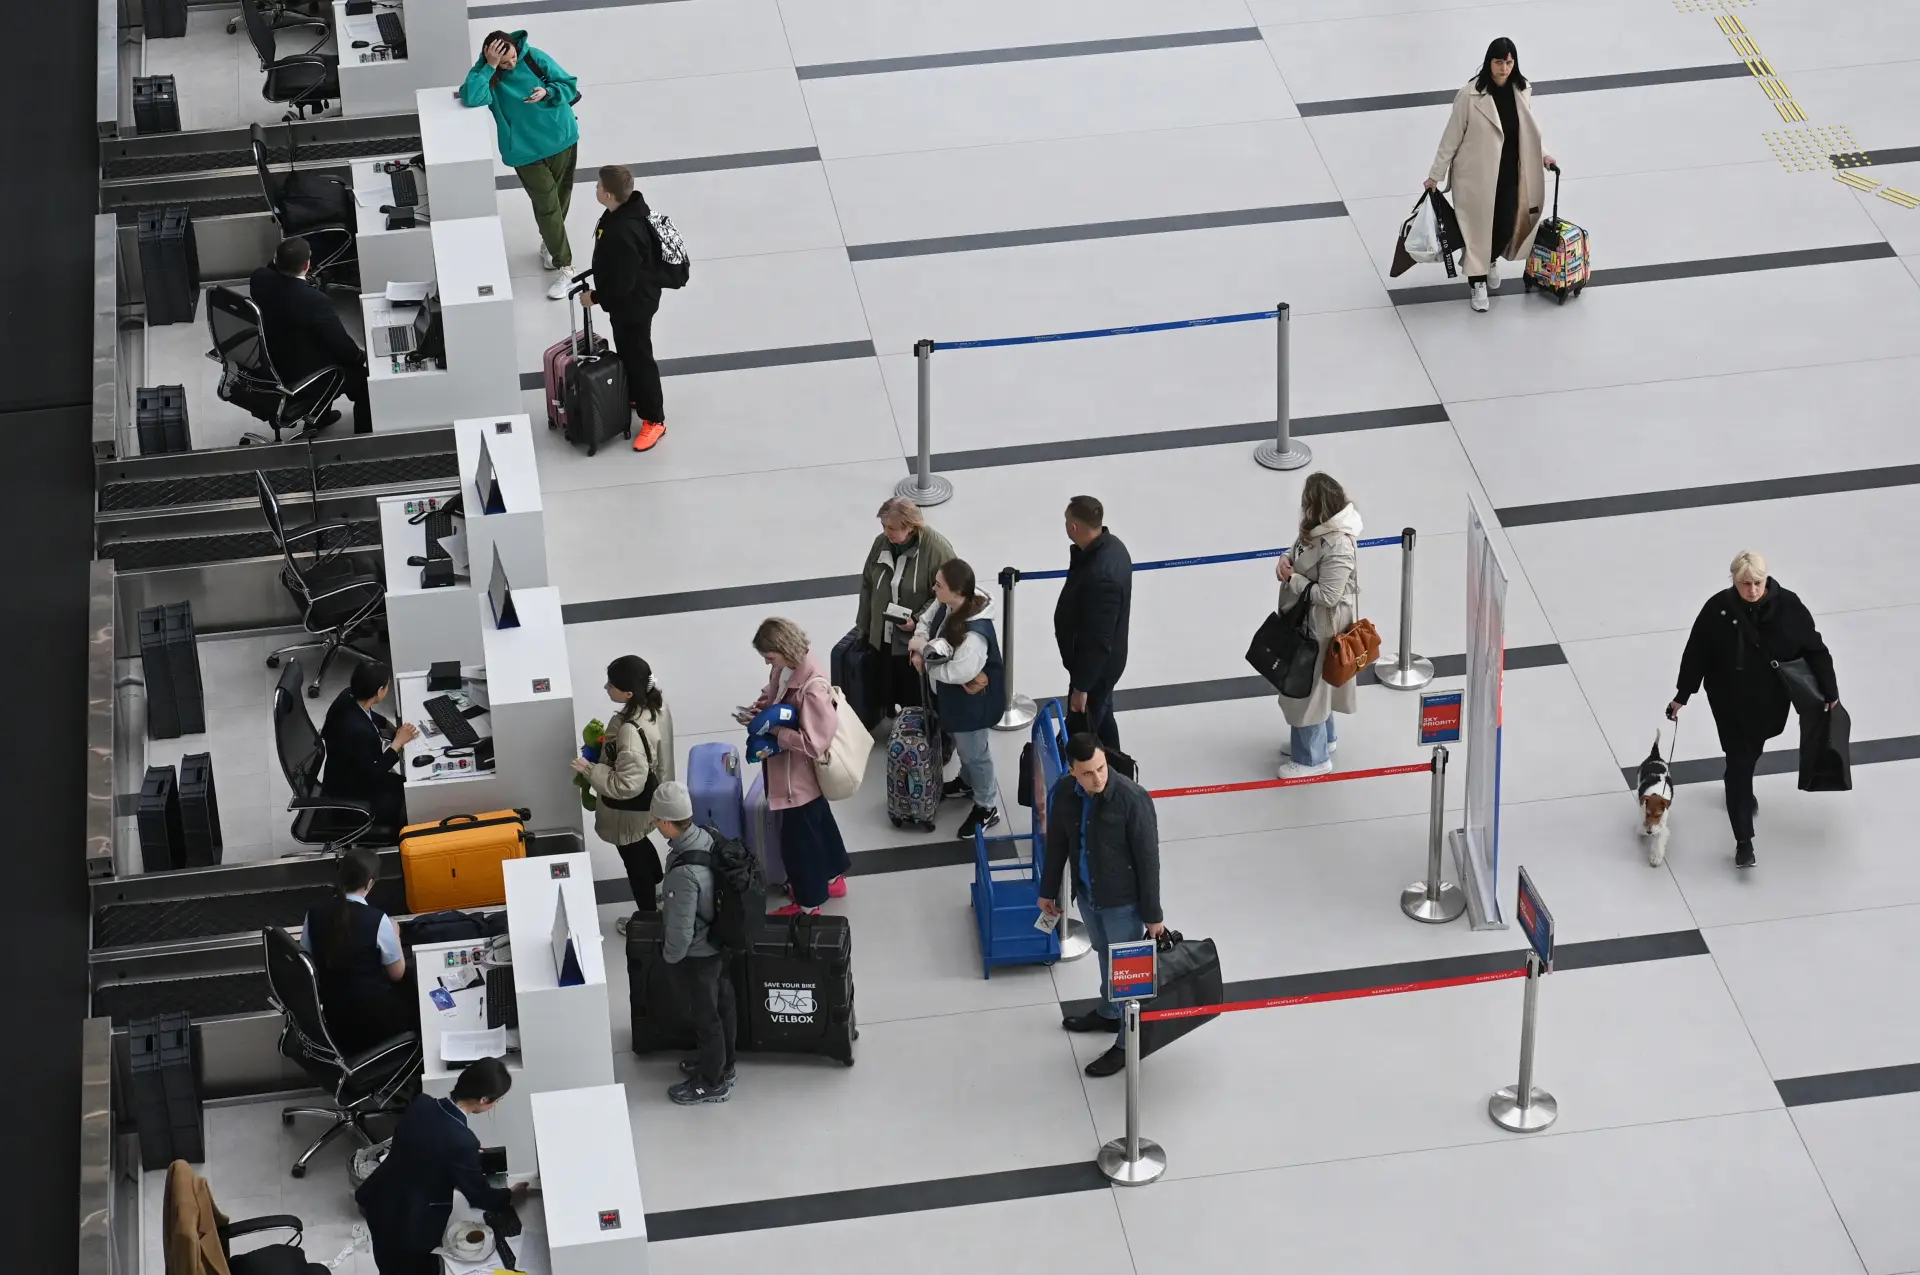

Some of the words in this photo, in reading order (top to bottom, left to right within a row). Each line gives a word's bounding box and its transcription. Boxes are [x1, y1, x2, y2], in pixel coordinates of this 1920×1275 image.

[1423, 719, 1457, 727] PRIORITY
[1113, 972, 1151, 981] PRIORITY
[771, 1015, 814, 1023] VELBOX
